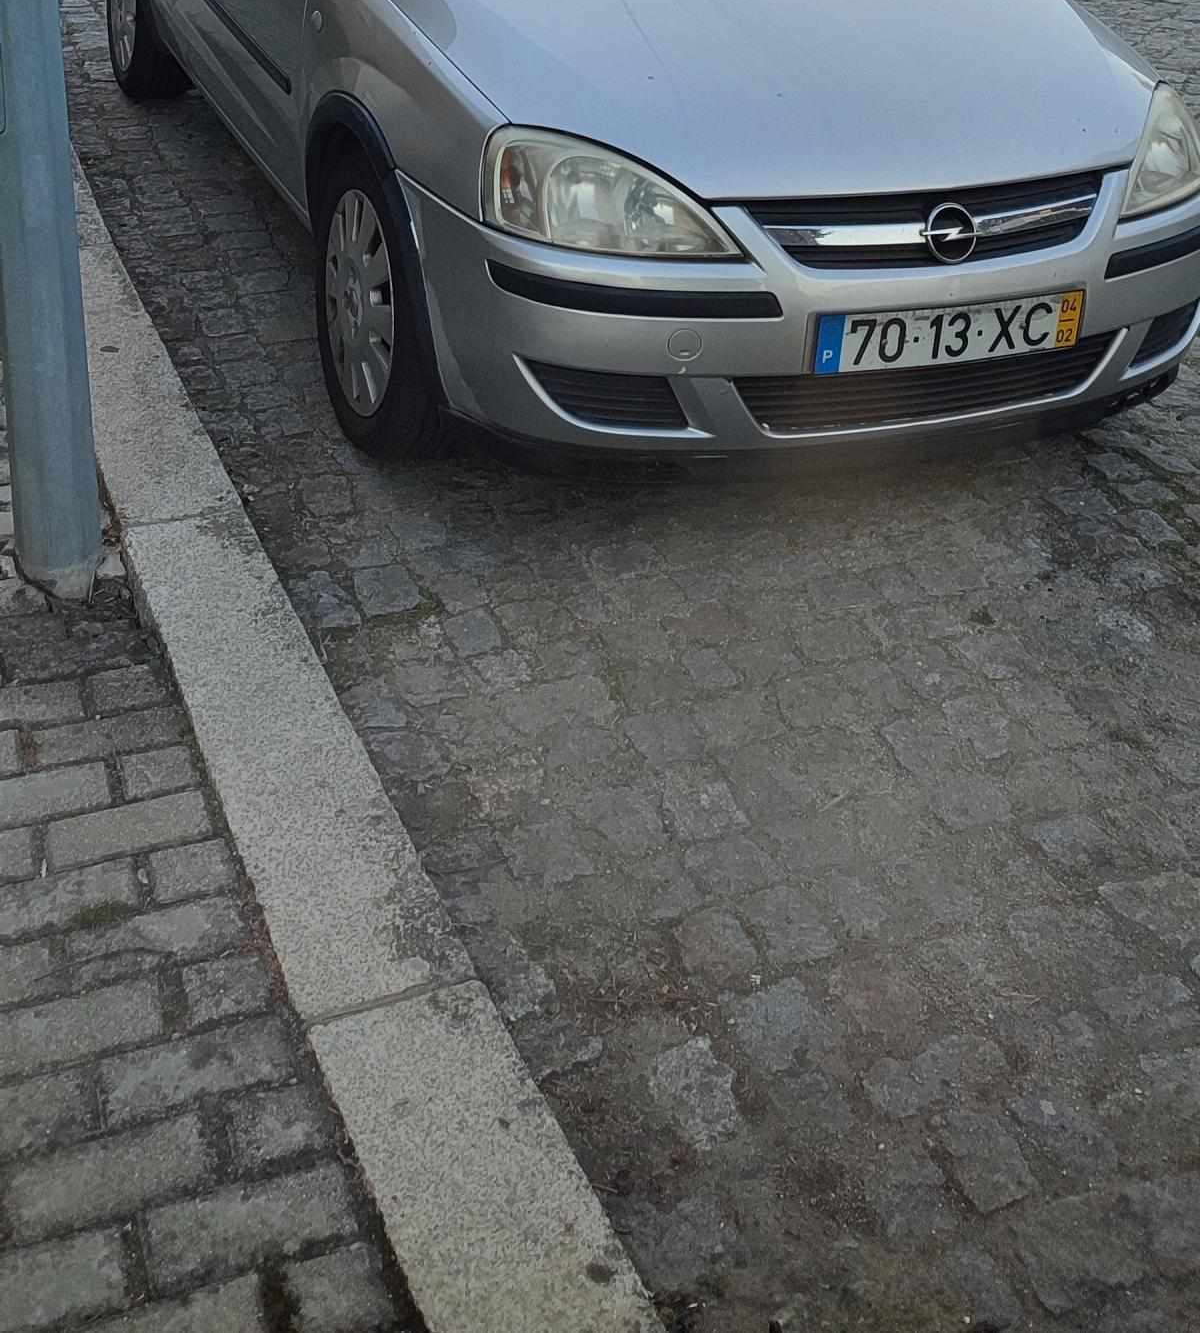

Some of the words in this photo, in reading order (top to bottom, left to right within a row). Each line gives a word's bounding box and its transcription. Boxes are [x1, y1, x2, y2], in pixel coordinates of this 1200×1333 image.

[1061, 298, 1077, 314] 04
[1055, 328, 1073, 344] 02
[822, 349, 833, 364] P
